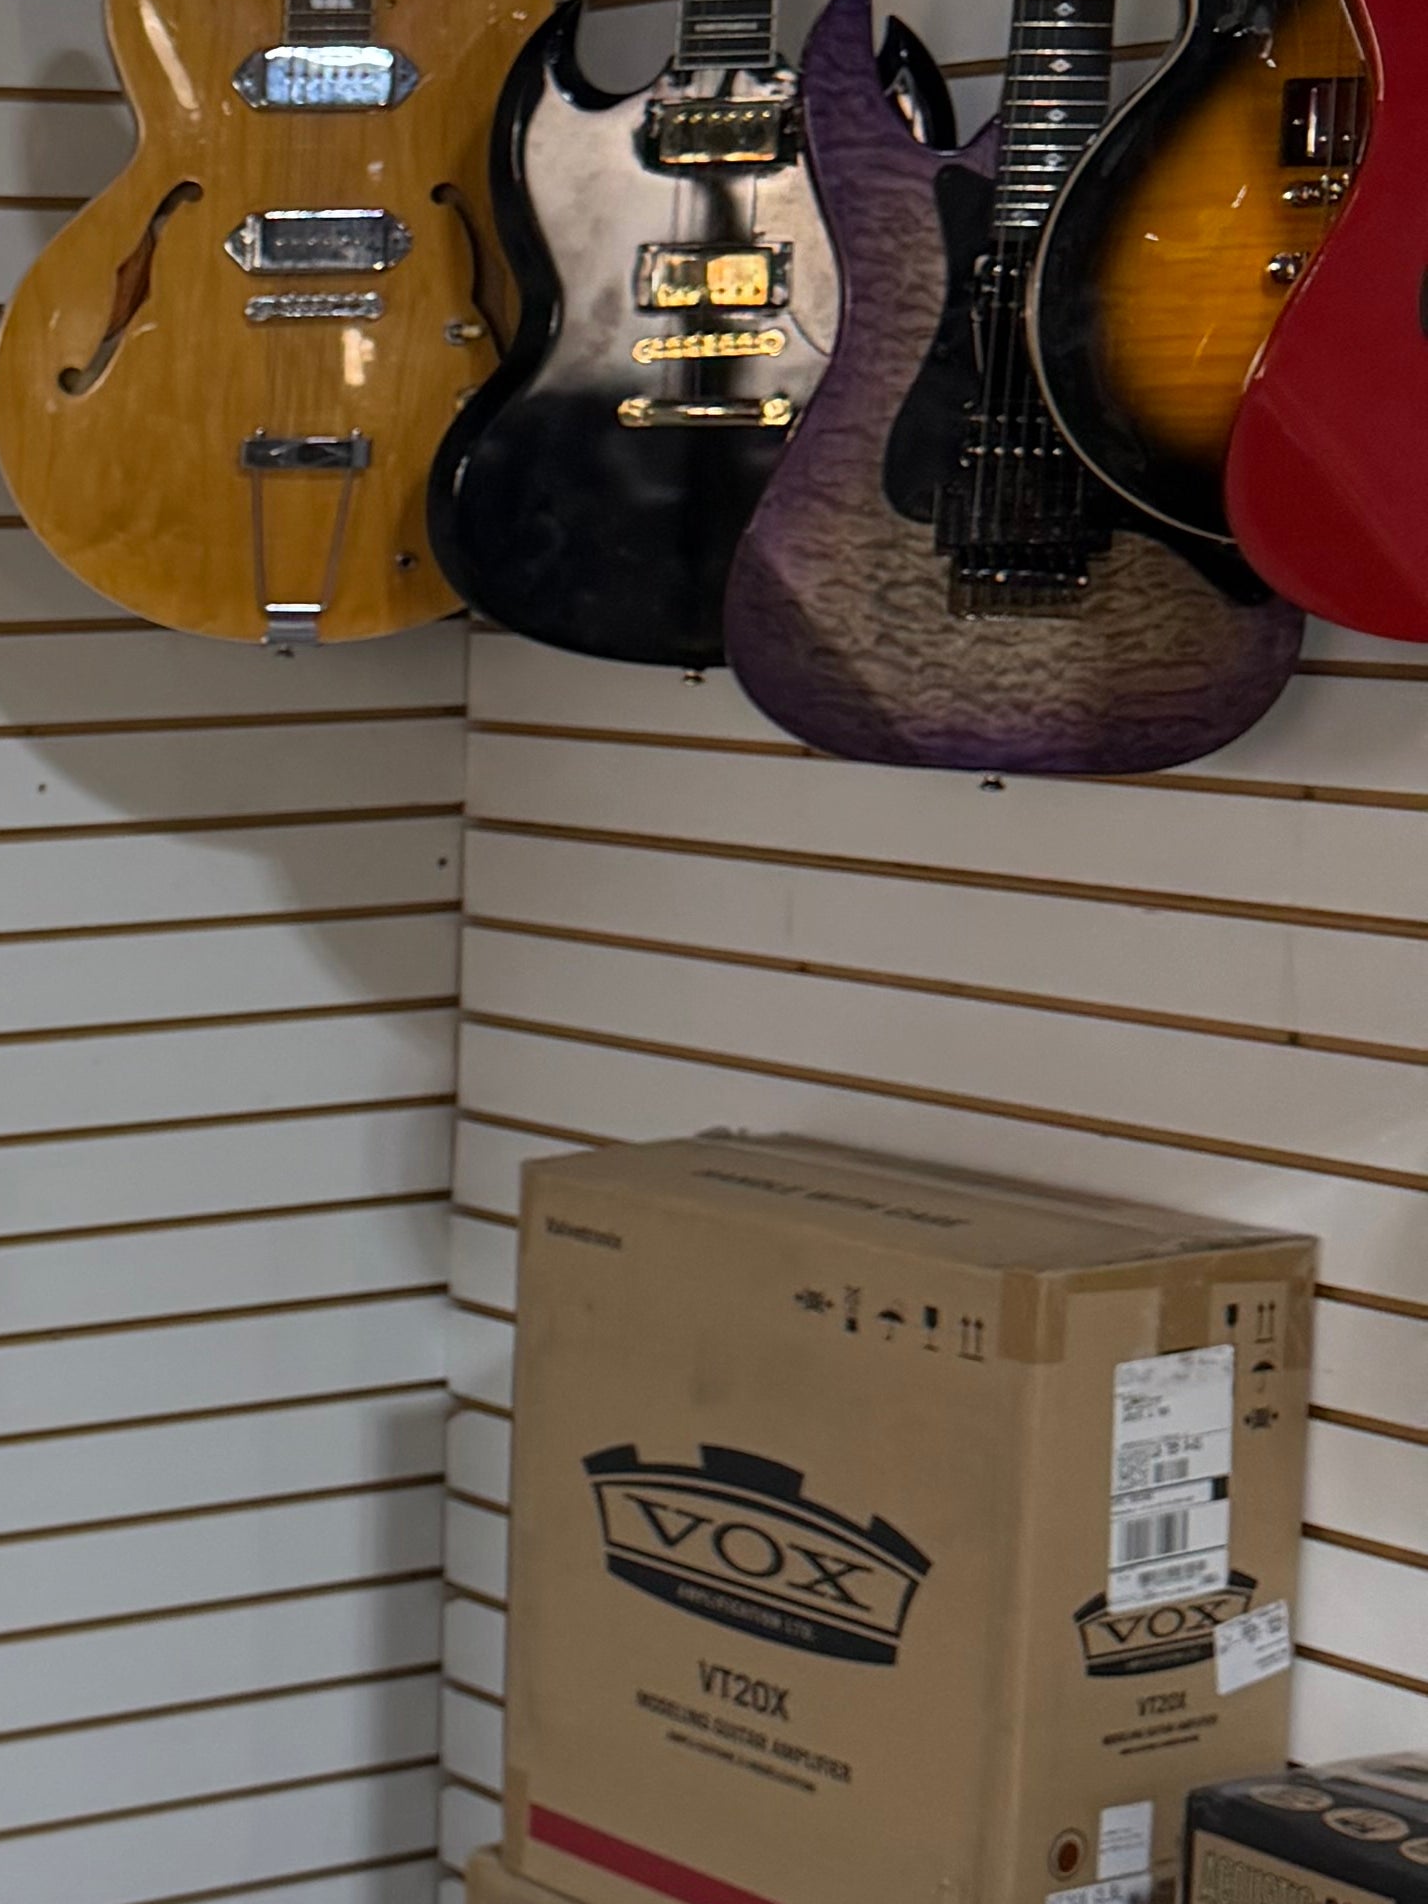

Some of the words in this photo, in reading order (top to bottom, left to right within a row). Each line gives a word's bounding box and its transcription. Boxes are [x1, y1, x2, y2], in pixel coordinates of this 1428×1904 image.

[623, 1492, 875, 1613] VOX
[1099, 1599, 1228, 1643] VOX
[698, 1658, 790, 1723] VT20X
